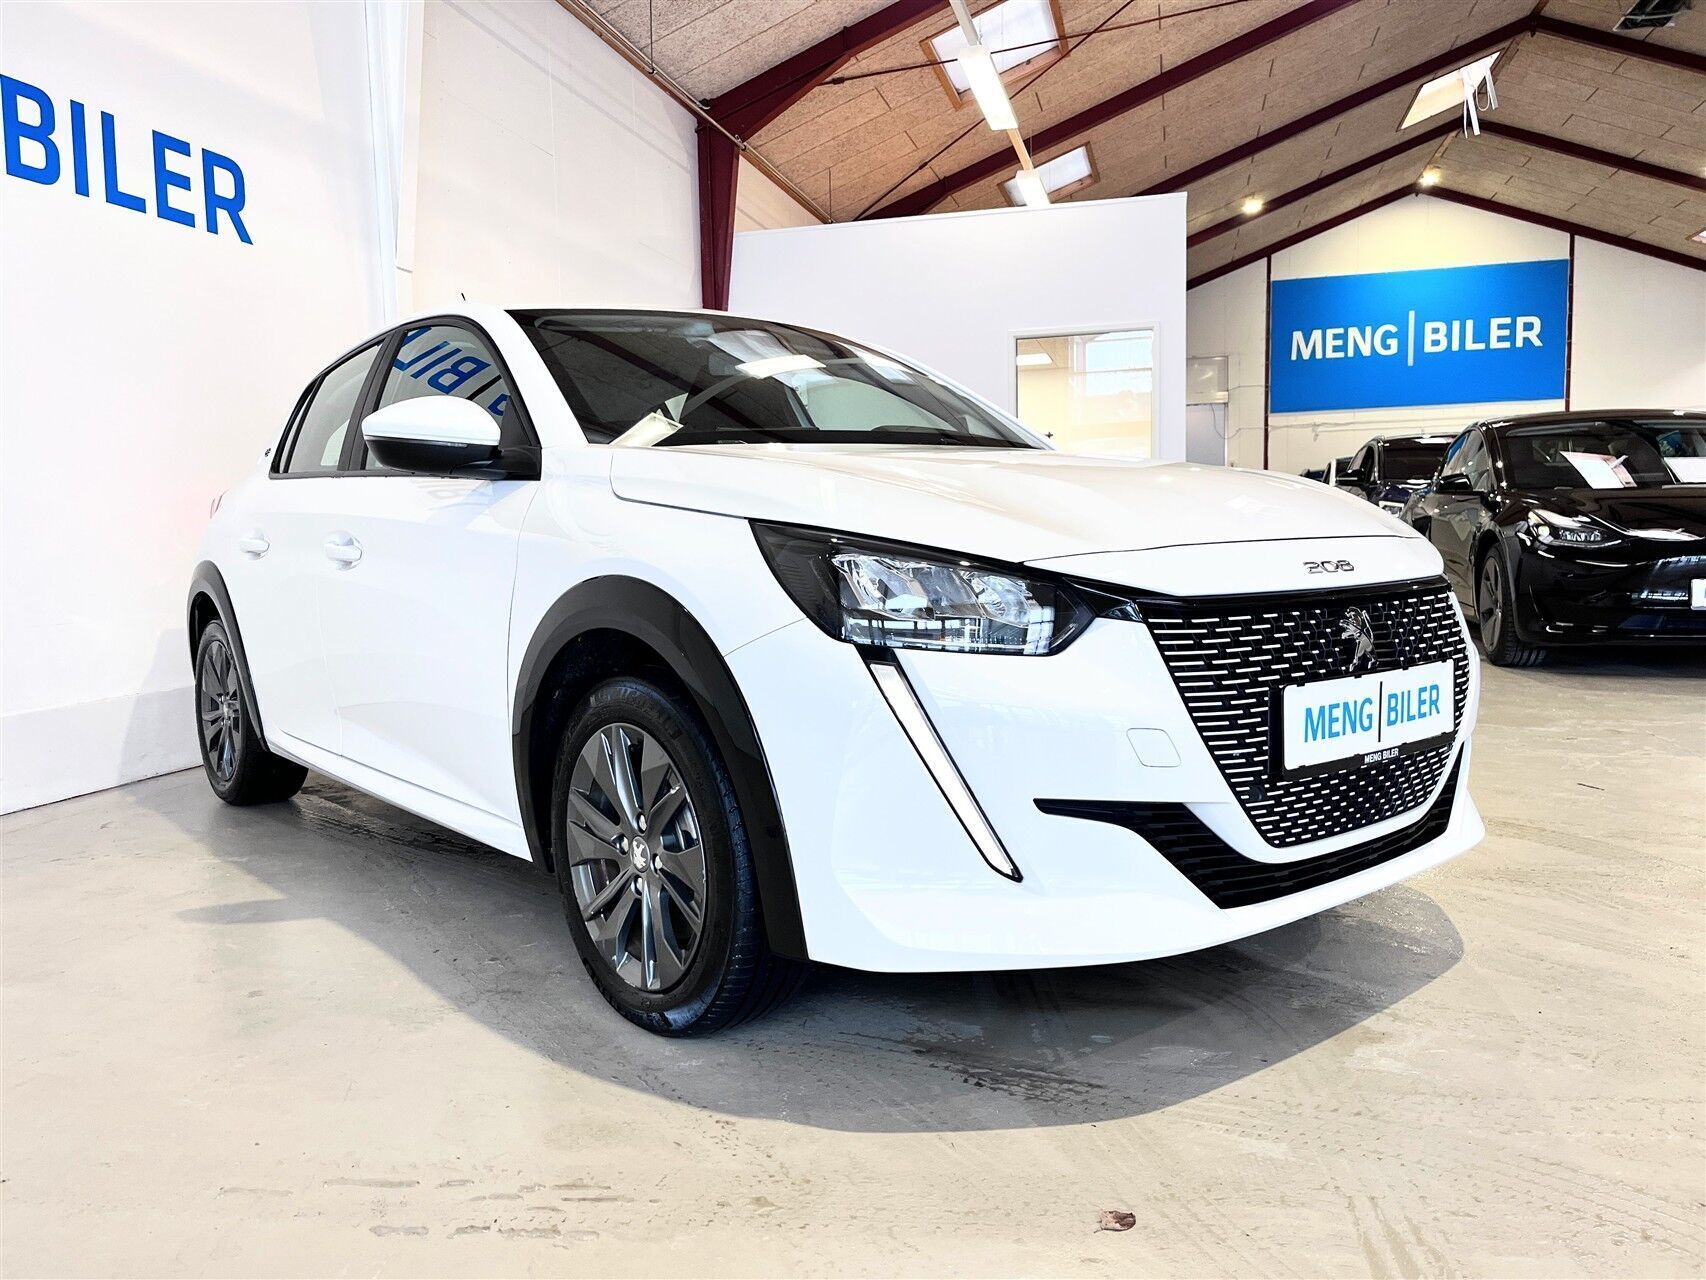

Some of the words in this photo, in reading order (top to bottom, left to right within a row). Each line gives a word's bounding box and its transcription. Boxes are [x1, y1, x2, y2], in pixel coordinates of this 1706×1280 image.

[0, 74, 253, 245] BILER
[1290, 323, 1399, 361] MENG
[1423, 315, 1543, 353] BILER
[1303, 559, 1355, 574] 208
[1303, 696, 1374, 743] MENG
[1386, 683, 1441, 727] BILER
[1364, 752, 1382, 764] MENG
[1382, 747, 1399, 760] BILER
